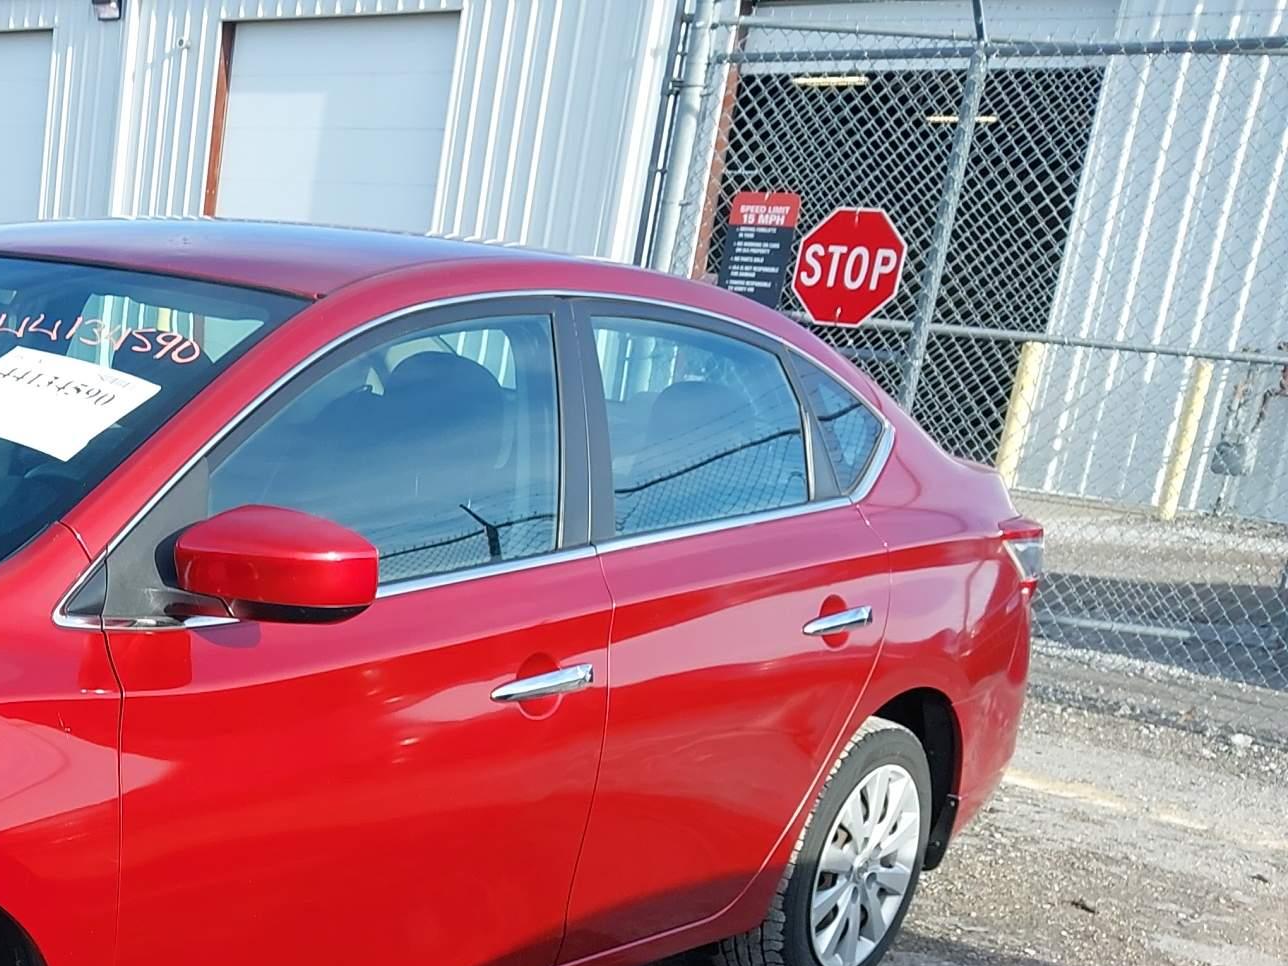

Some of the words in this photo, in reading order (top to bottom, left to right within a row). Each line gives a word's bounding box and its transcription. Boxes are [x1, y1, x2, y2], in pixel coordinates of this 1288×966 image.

[740, 204, 767, 214] SPEED
[768, 205, 791, 216] LIMIT
[743, 213, 755, 225] 15
[758, 213, 785, 226] MPH
[800, 243, 897, 291] STOP
[0, 367, 116, 406] 44134590
